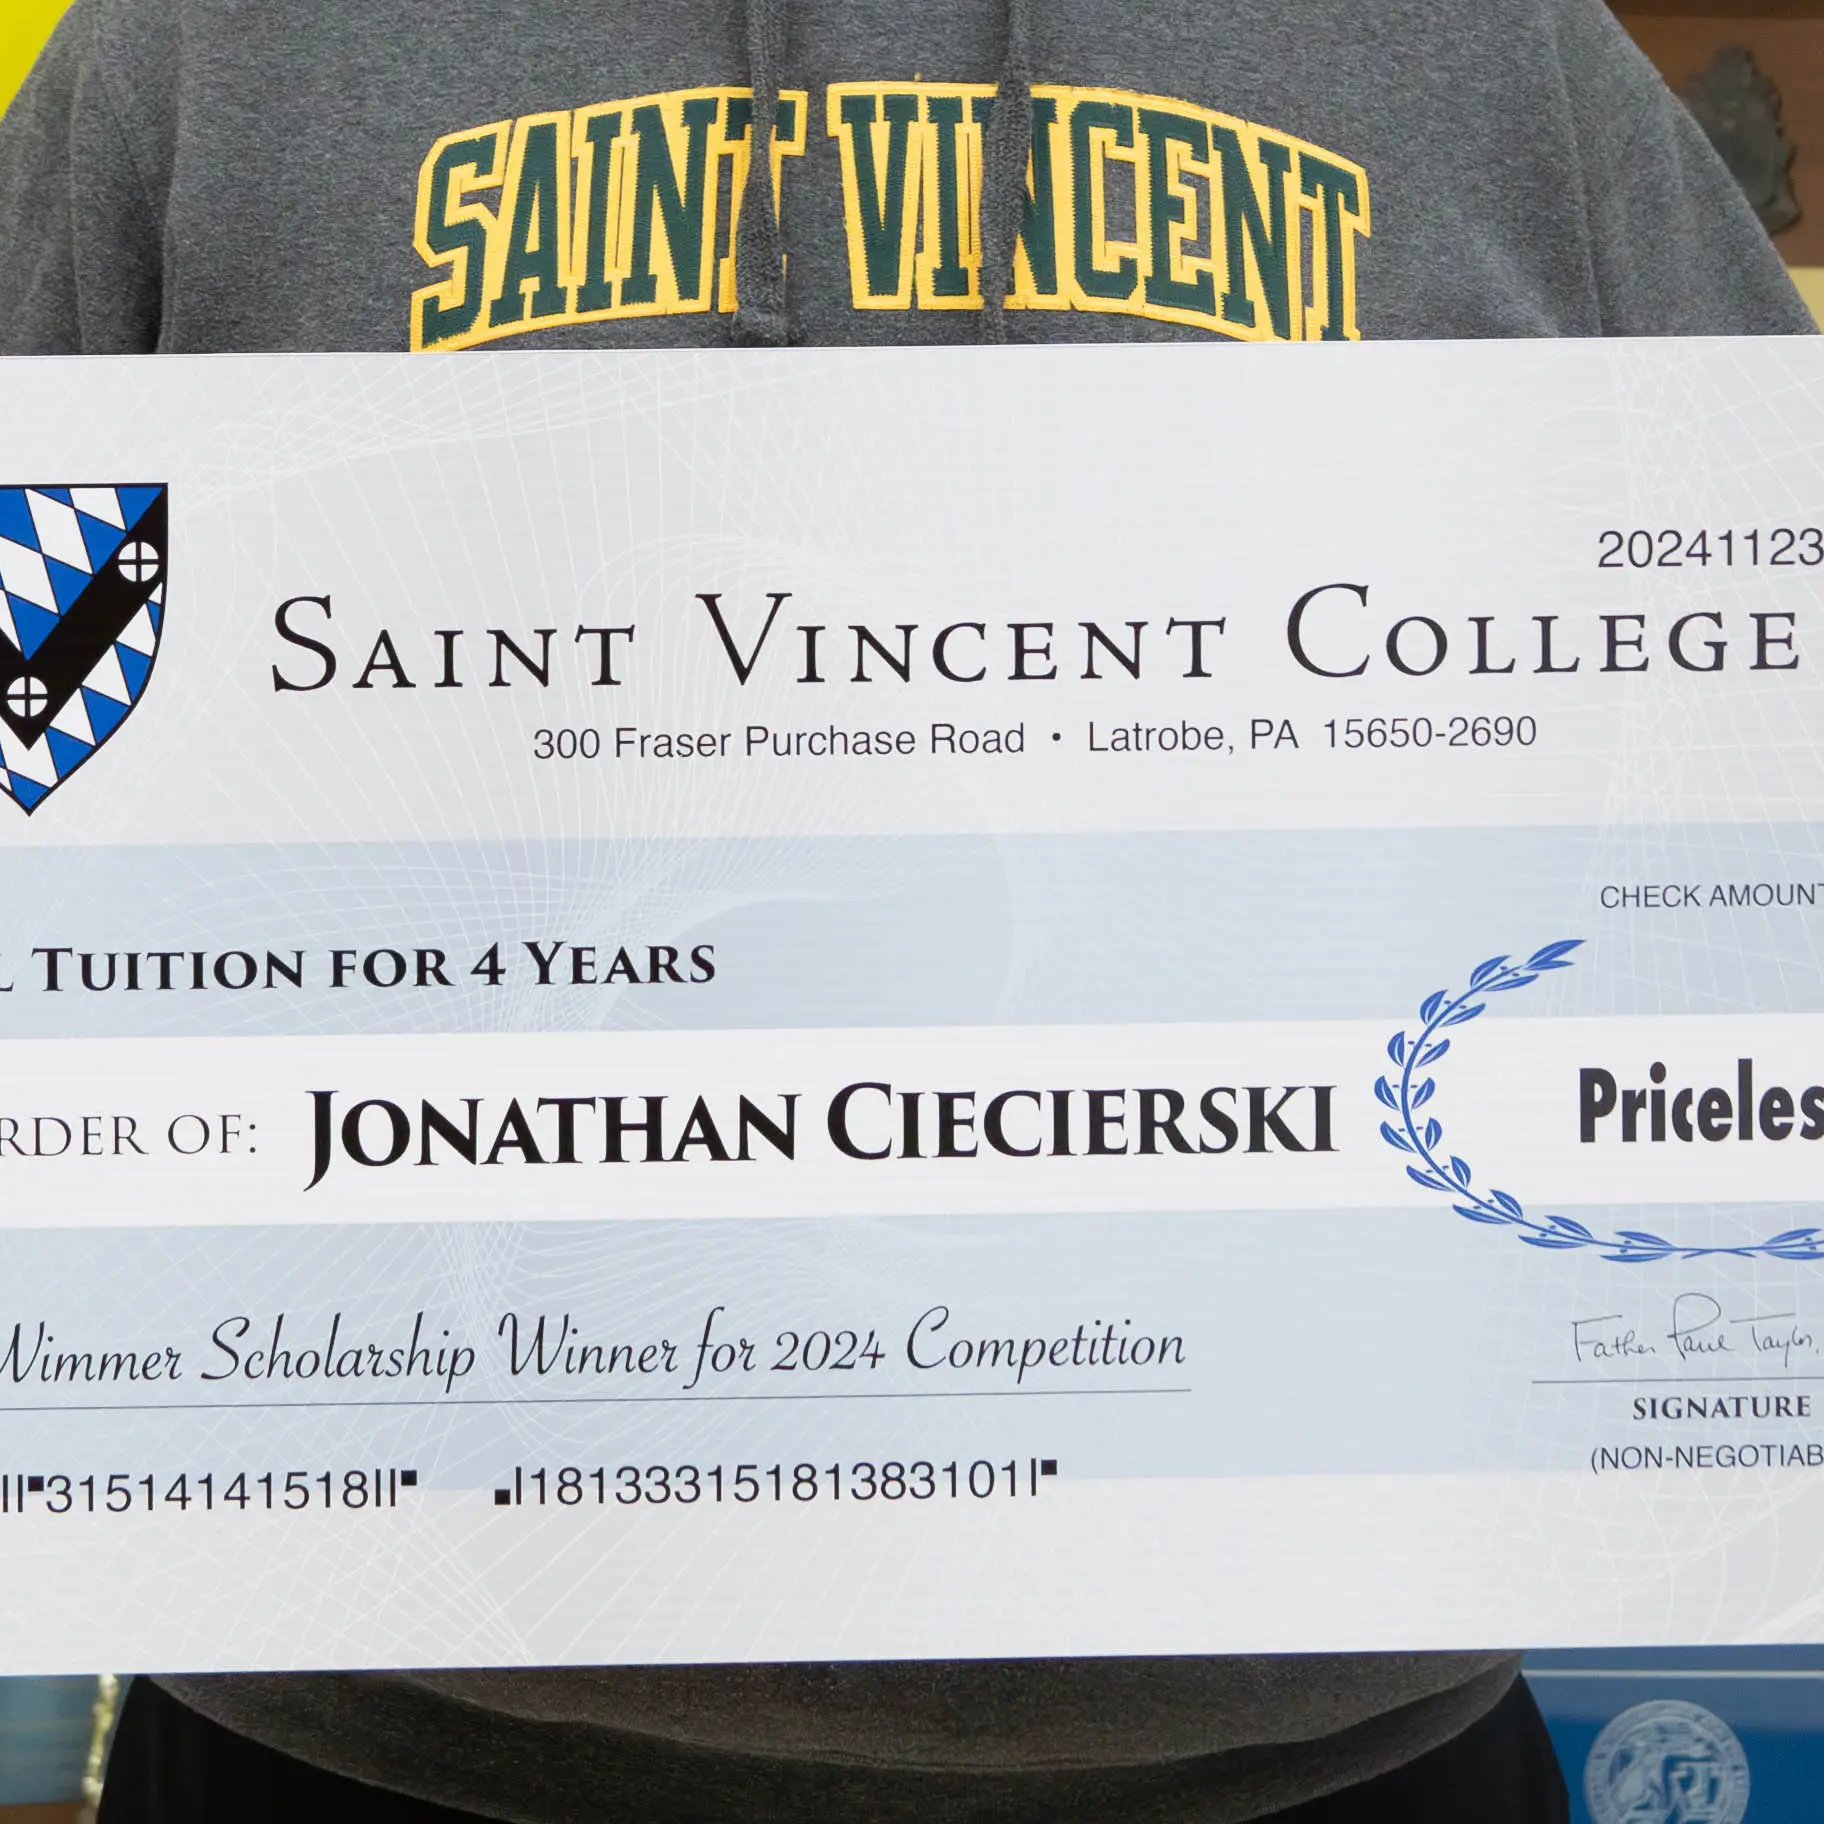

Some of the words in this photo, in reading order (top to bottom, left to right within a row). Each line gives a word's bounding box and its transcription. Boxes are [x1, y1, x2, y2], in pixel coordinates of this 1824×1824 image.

[827, 81, 1368, 341] VINCENT
[533, 728, 601, 760] 300
[615, 727, 732, 759] Fraser
[746, 724, 916, 757] Purchase
[931, 721, 1025, 755] Road
[1088, 719, 1234, 755] Latrobe,
[1250, 718, 1300, 750] PA
[1323, 715, 1537, 749] 15650-2690
[1600, 884, 1701, 909] CHECK
[469, 941, 507, 986] 4
[167, 1113, 257, 1155] OF:
[200, 1310, 476, 1395] Scholarship
[497, 1312, 679, 1376] Winner
[682, 1305, 757, 1390] for
[769, 1329, 886, 1371] 2024
[906, 1305, 1186, 1385] Competition
[1632, 1395, 1812, 1421] SIGNATURE
